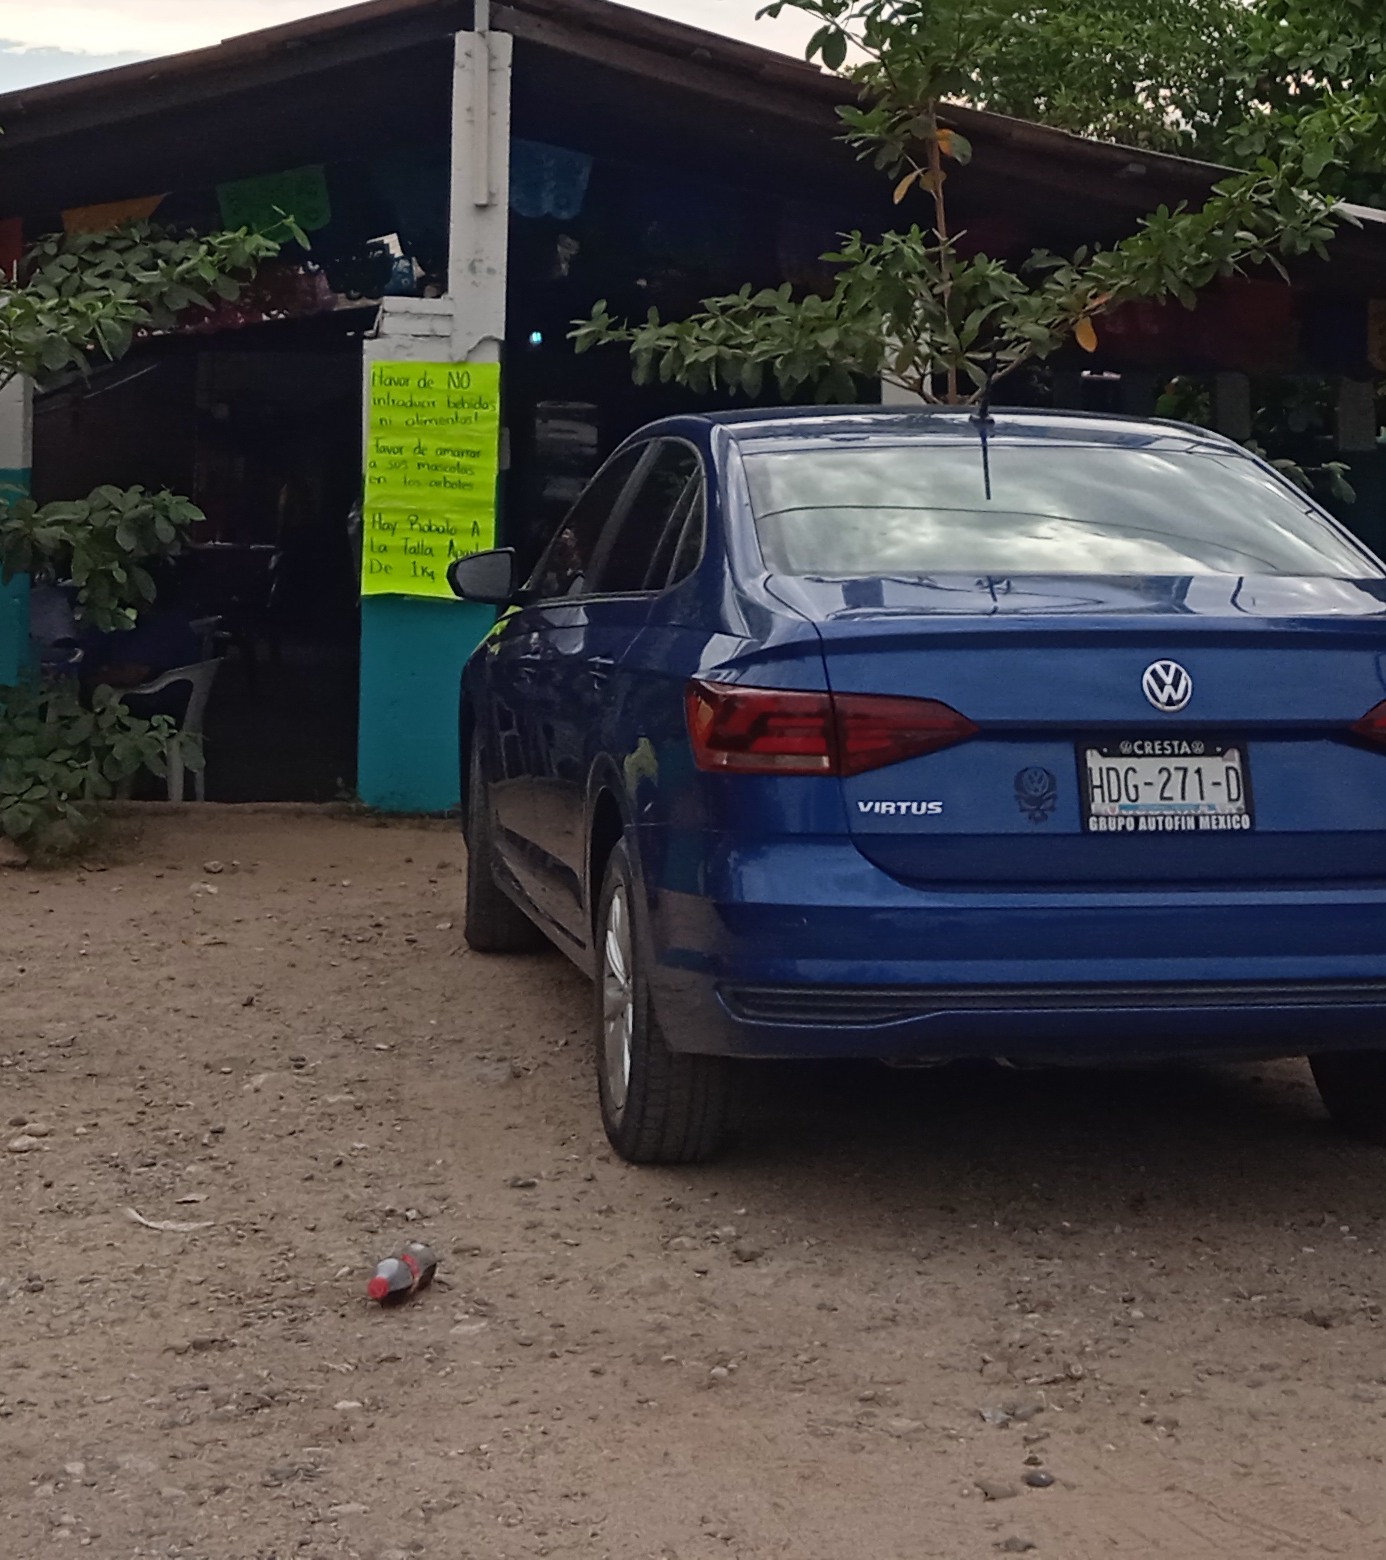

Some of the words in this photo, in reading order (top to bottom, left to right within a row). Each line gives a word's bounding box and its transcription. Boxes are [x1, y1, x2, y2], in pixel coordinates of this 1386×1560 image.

[416, 369, 435, 389] de
[447, 369, 471, 390] NO
[446, 394, 497, 411] bebidas
[379, 415, 392, 427] ni
[412, 437, 428, 457] de
[434, 446, 482, 459] amarrar
[371, 512, 398, 537] Hay
[470, 520, 481, 538] A
[370, 537, 388, 553] La
[401, 536, 434, 558] Talla
[369, 558, 394, 575] De
[1132, 740, 1192, 755] CRESTA
[1088, 765, 1242, 804] HDG-271-D
[857, 801, 943, 815] VIRTUS
[1088, 815, 1135, 832] GRUPO
[1137, 815, 1196, 831] AUTOFIN
[1198, 813, 1251, 831] MEXICO
